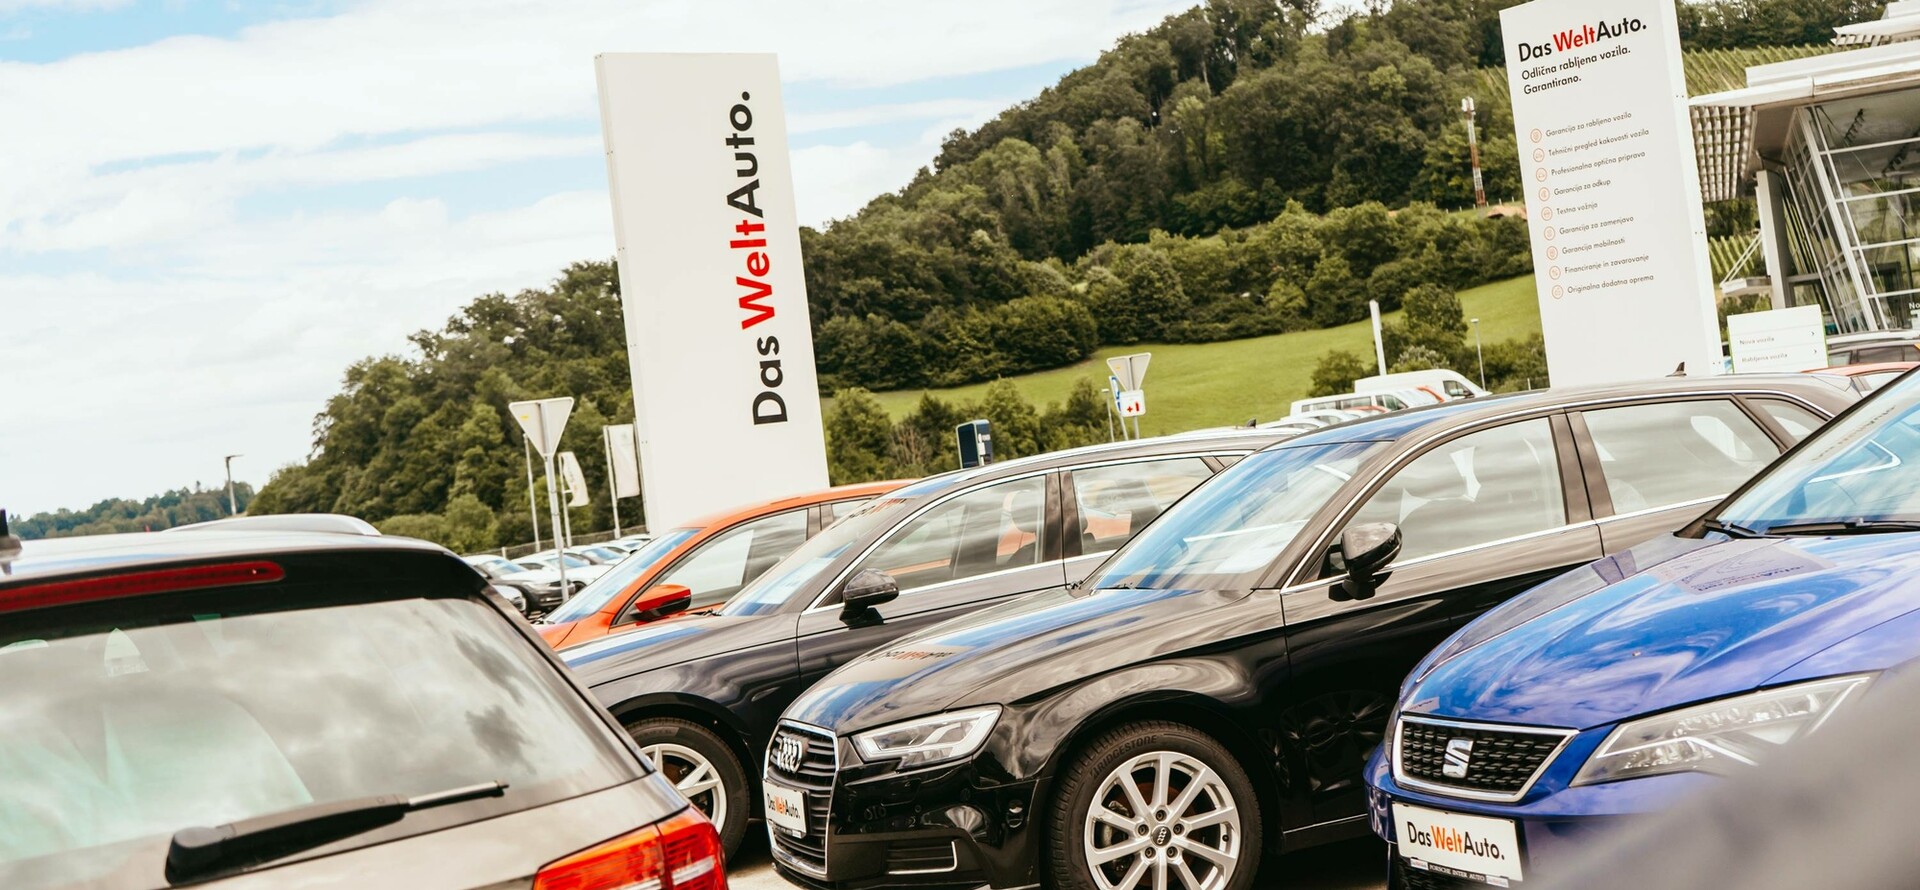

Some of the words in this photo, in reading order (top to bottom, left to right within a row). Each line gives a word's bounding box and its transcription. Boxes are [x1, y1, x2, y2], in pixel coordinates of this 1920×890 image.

[1521, 66, 1557, 80] Odlična
[1559, 55, 1598, 71] rabljena
[1600, 44, 1631, 60] vozila.
[1523, 75, 1582, 95] Garantirano.
[1546, 126, 1576, 138] Garancija
[1586, 116, 1612, 128] rabljeno
[1574, 139, 1598, 152] pregled
[1599, 132, 1629, 145] kakovosti
[1553, 185, 1583, 196] Garancija
[1592, 179, 1611, 188] odkup
[1556, 205, 1576, 215] Testna
[1559, 224, 1590, 235] Garancija
[1562, 243, 1593, 255] Garancija
[1593, 236, 1626, 249] mobilnosti
[1567, 282, 1600, 294] Originalna
[1601, 278, 1628, 289] dodatna
[1629, 274, 1654, 284] oprema
[1089, 734, 1158, 778] BRIDGESTONE
